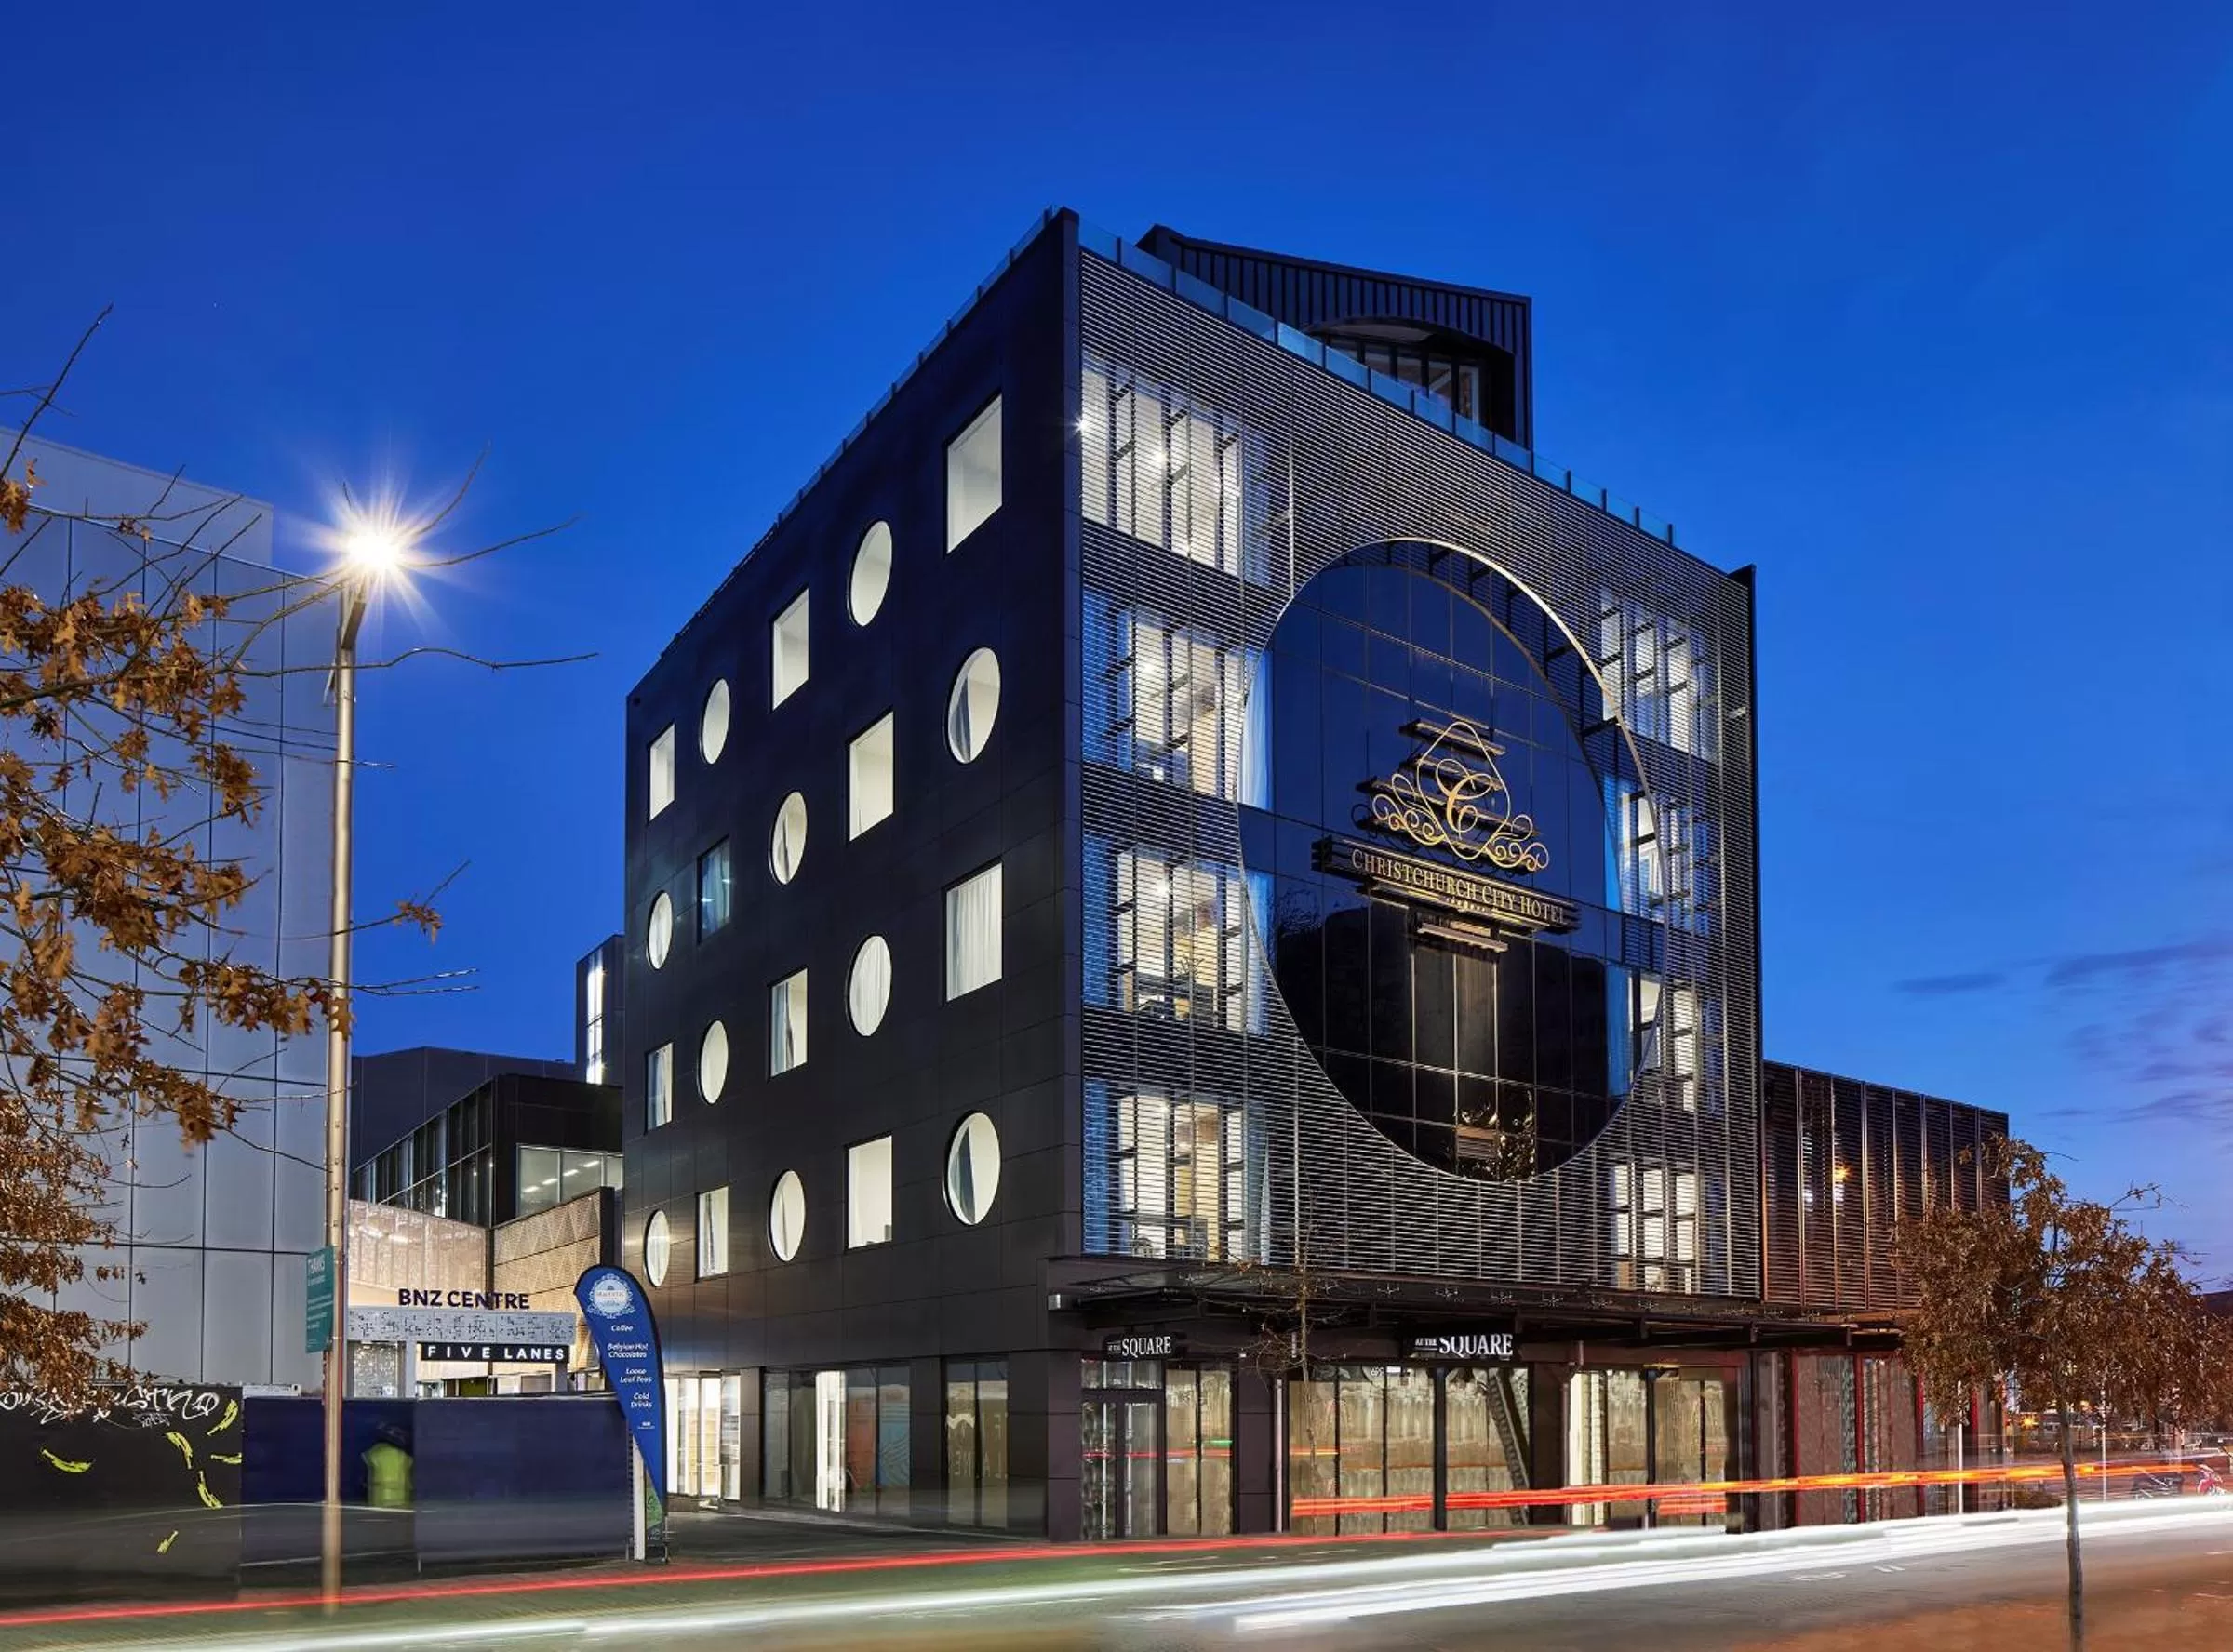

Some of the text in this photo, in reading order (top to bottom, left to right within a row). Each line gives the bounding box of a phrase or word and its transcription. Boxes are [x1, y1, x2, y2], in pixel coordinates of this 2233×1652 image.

[1351, 849, 1567, 924] CHRISTCHURCH CITY HOTEL
[398, 1288, 530, 1310] BNZ CENTRE
[610, 1324, 634, 1332] Coffee
[428, 1346, 564, 1360] FIVE LANES
[1121, 1336, 1171, 1358] SQUARE
[1424, 1337, 1437, 1346] THE
[1438, 1334, 1514, 1358] SQUARE
[630, 1400, 653, 1408] Drinks
